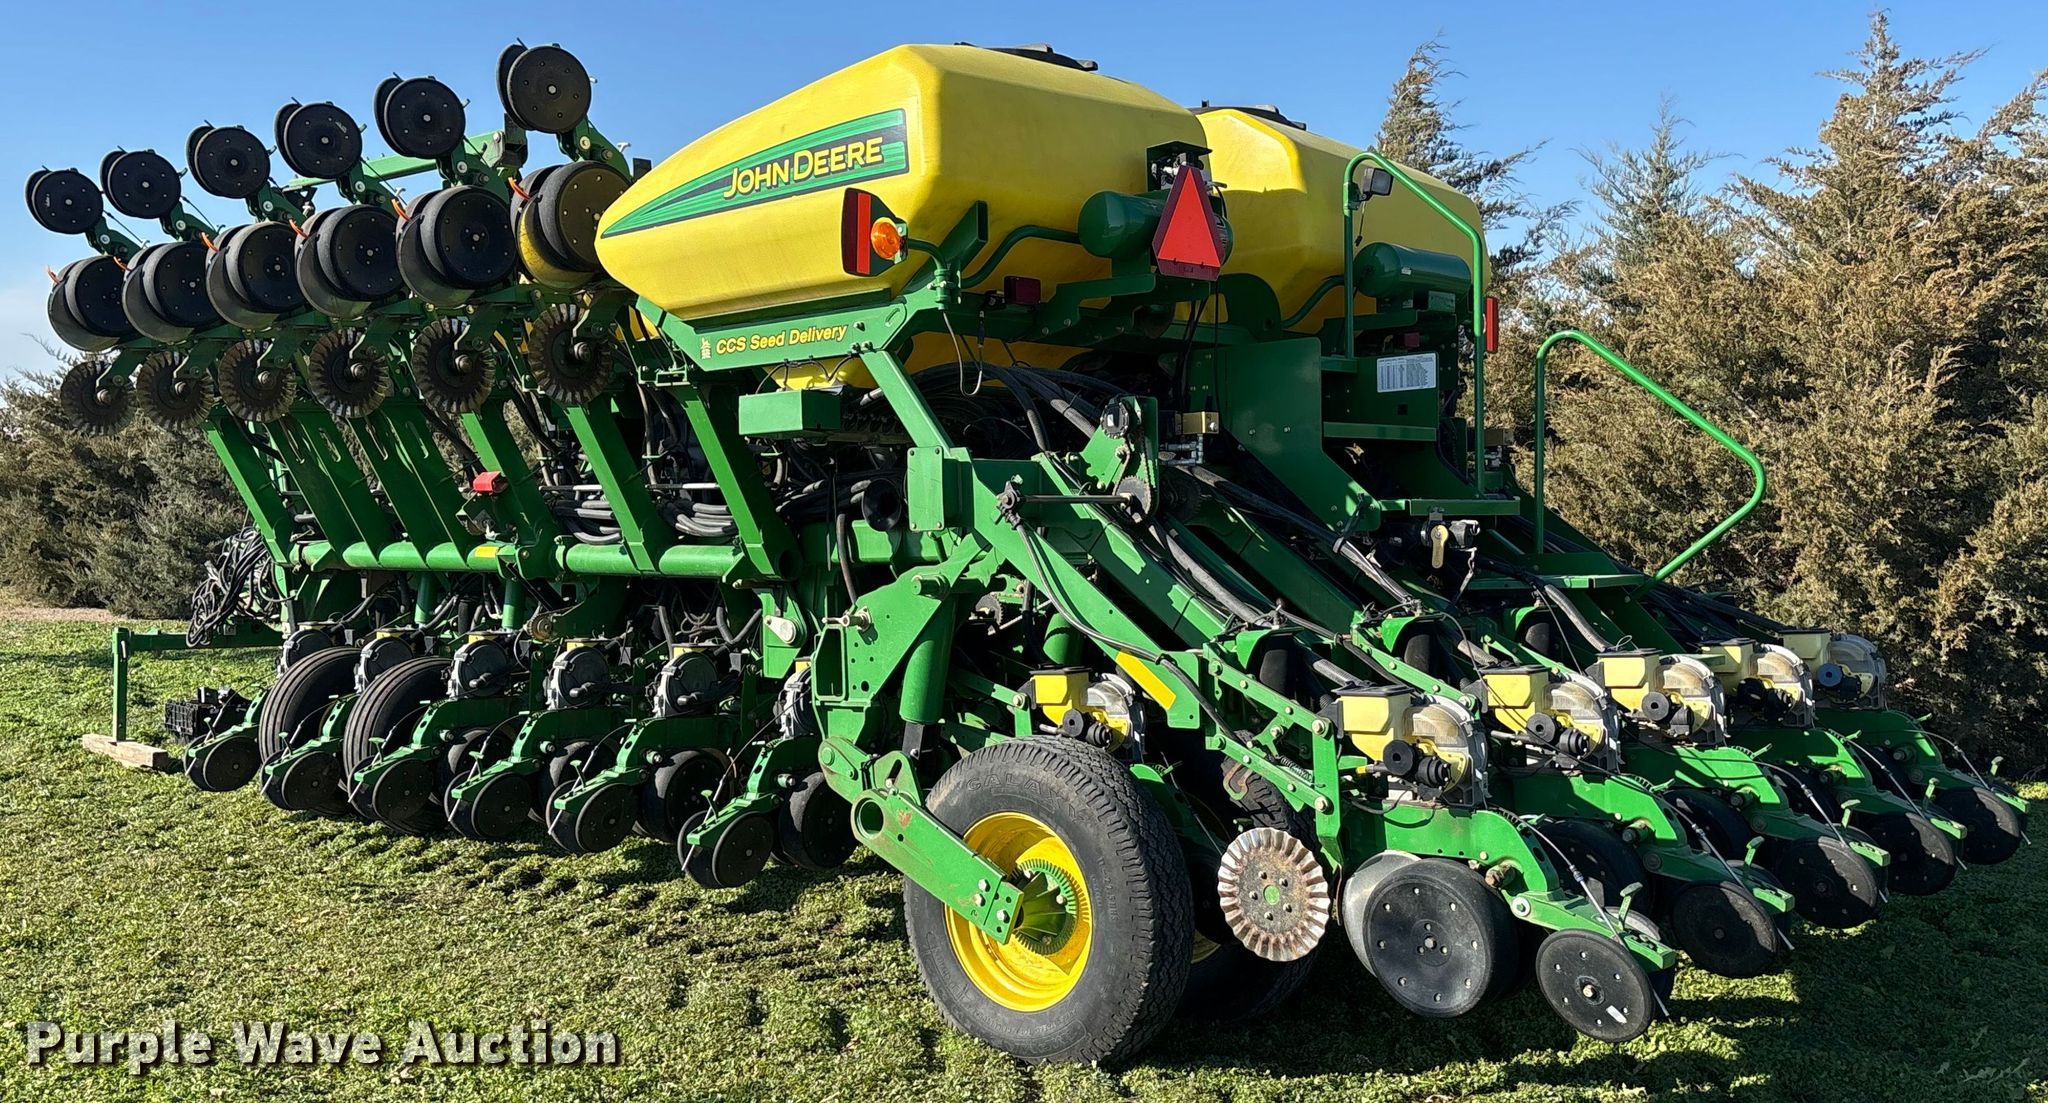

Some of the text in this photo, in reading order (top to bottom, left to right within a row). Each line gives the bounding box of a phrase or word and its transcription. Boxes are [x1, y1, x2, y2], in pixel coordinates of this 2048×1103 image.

[724, 137, 883, 198] JOHN DEERE
[716, 325, 848, 354] CCS Seed Delivery
